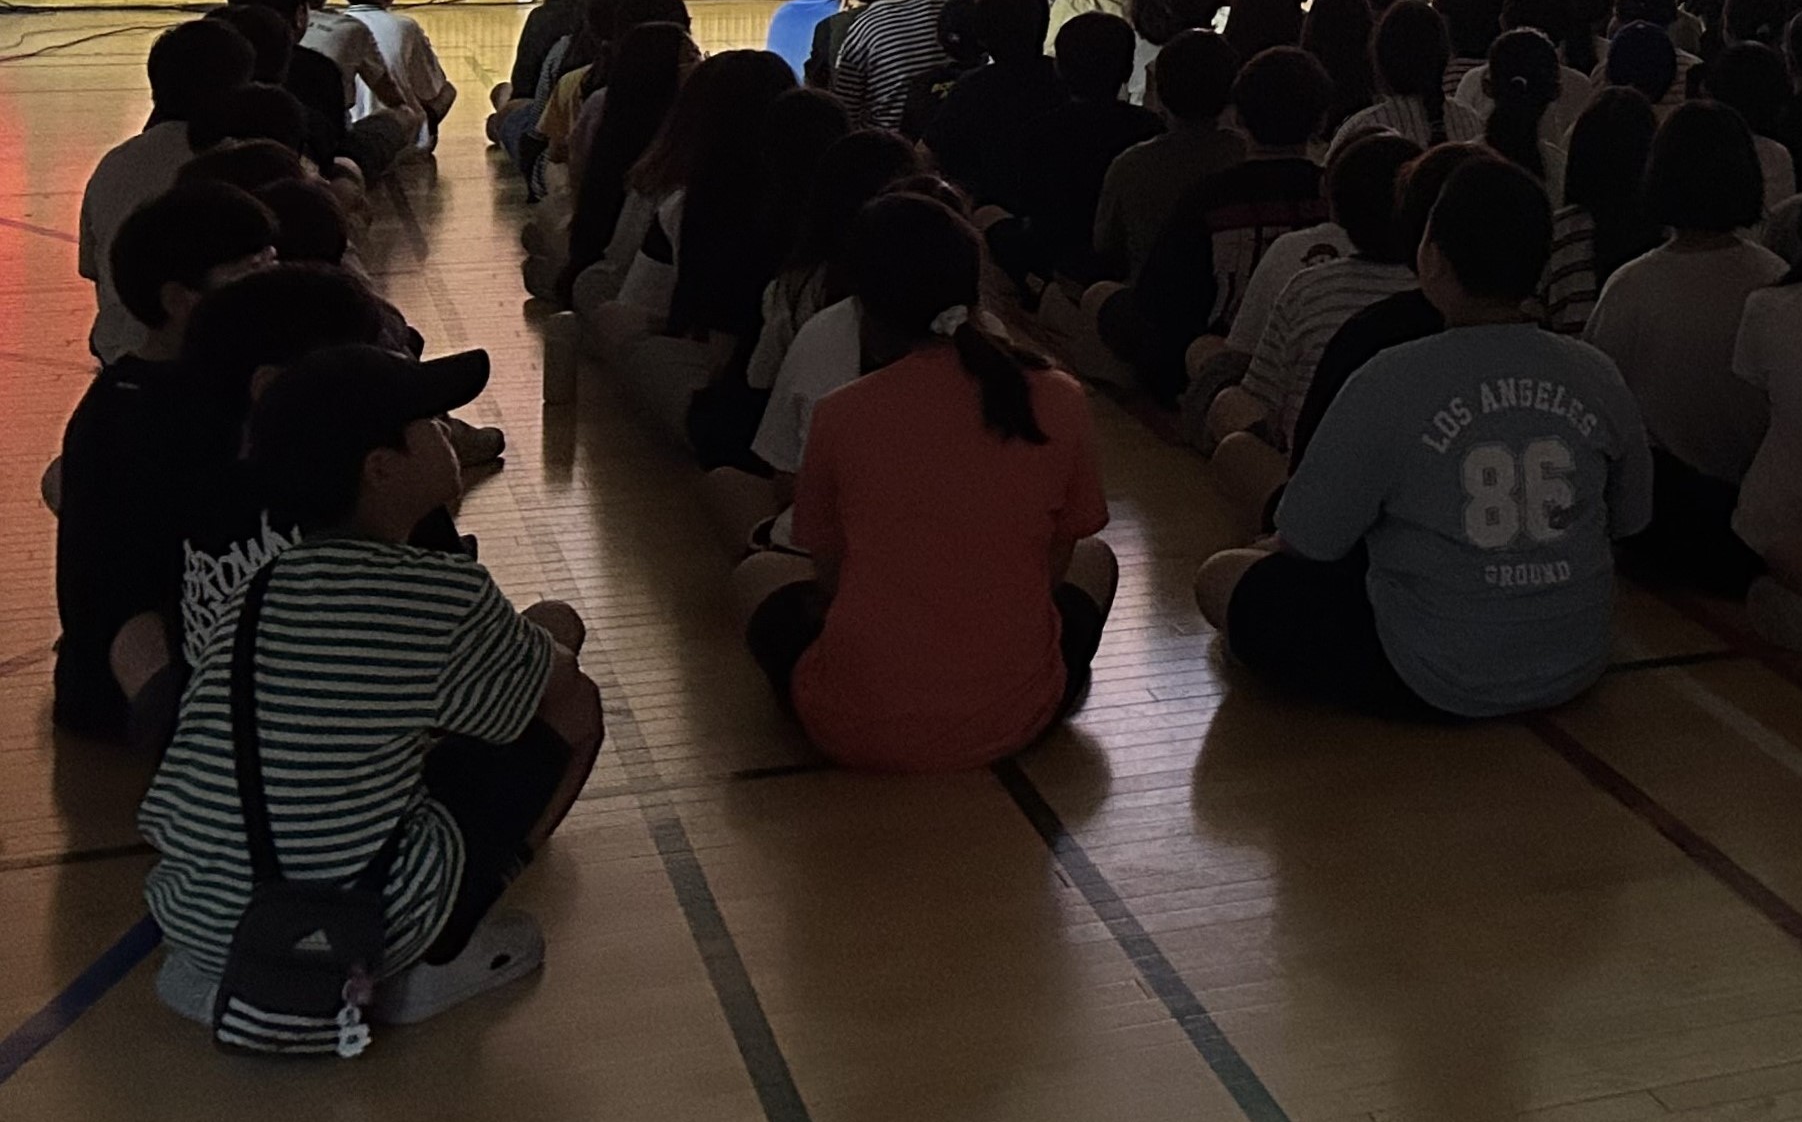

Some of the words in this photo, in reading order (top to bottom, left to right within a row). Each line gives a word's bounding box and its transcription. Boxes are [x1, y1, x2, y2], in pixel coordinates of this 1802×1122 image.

[1421, 396, 1473, 455] LOS
[1479, 377, 1598, 438] ANGELES
[1461, 435, 1576, 550] 86
[1484, 559, 1572, 587] GROUND
